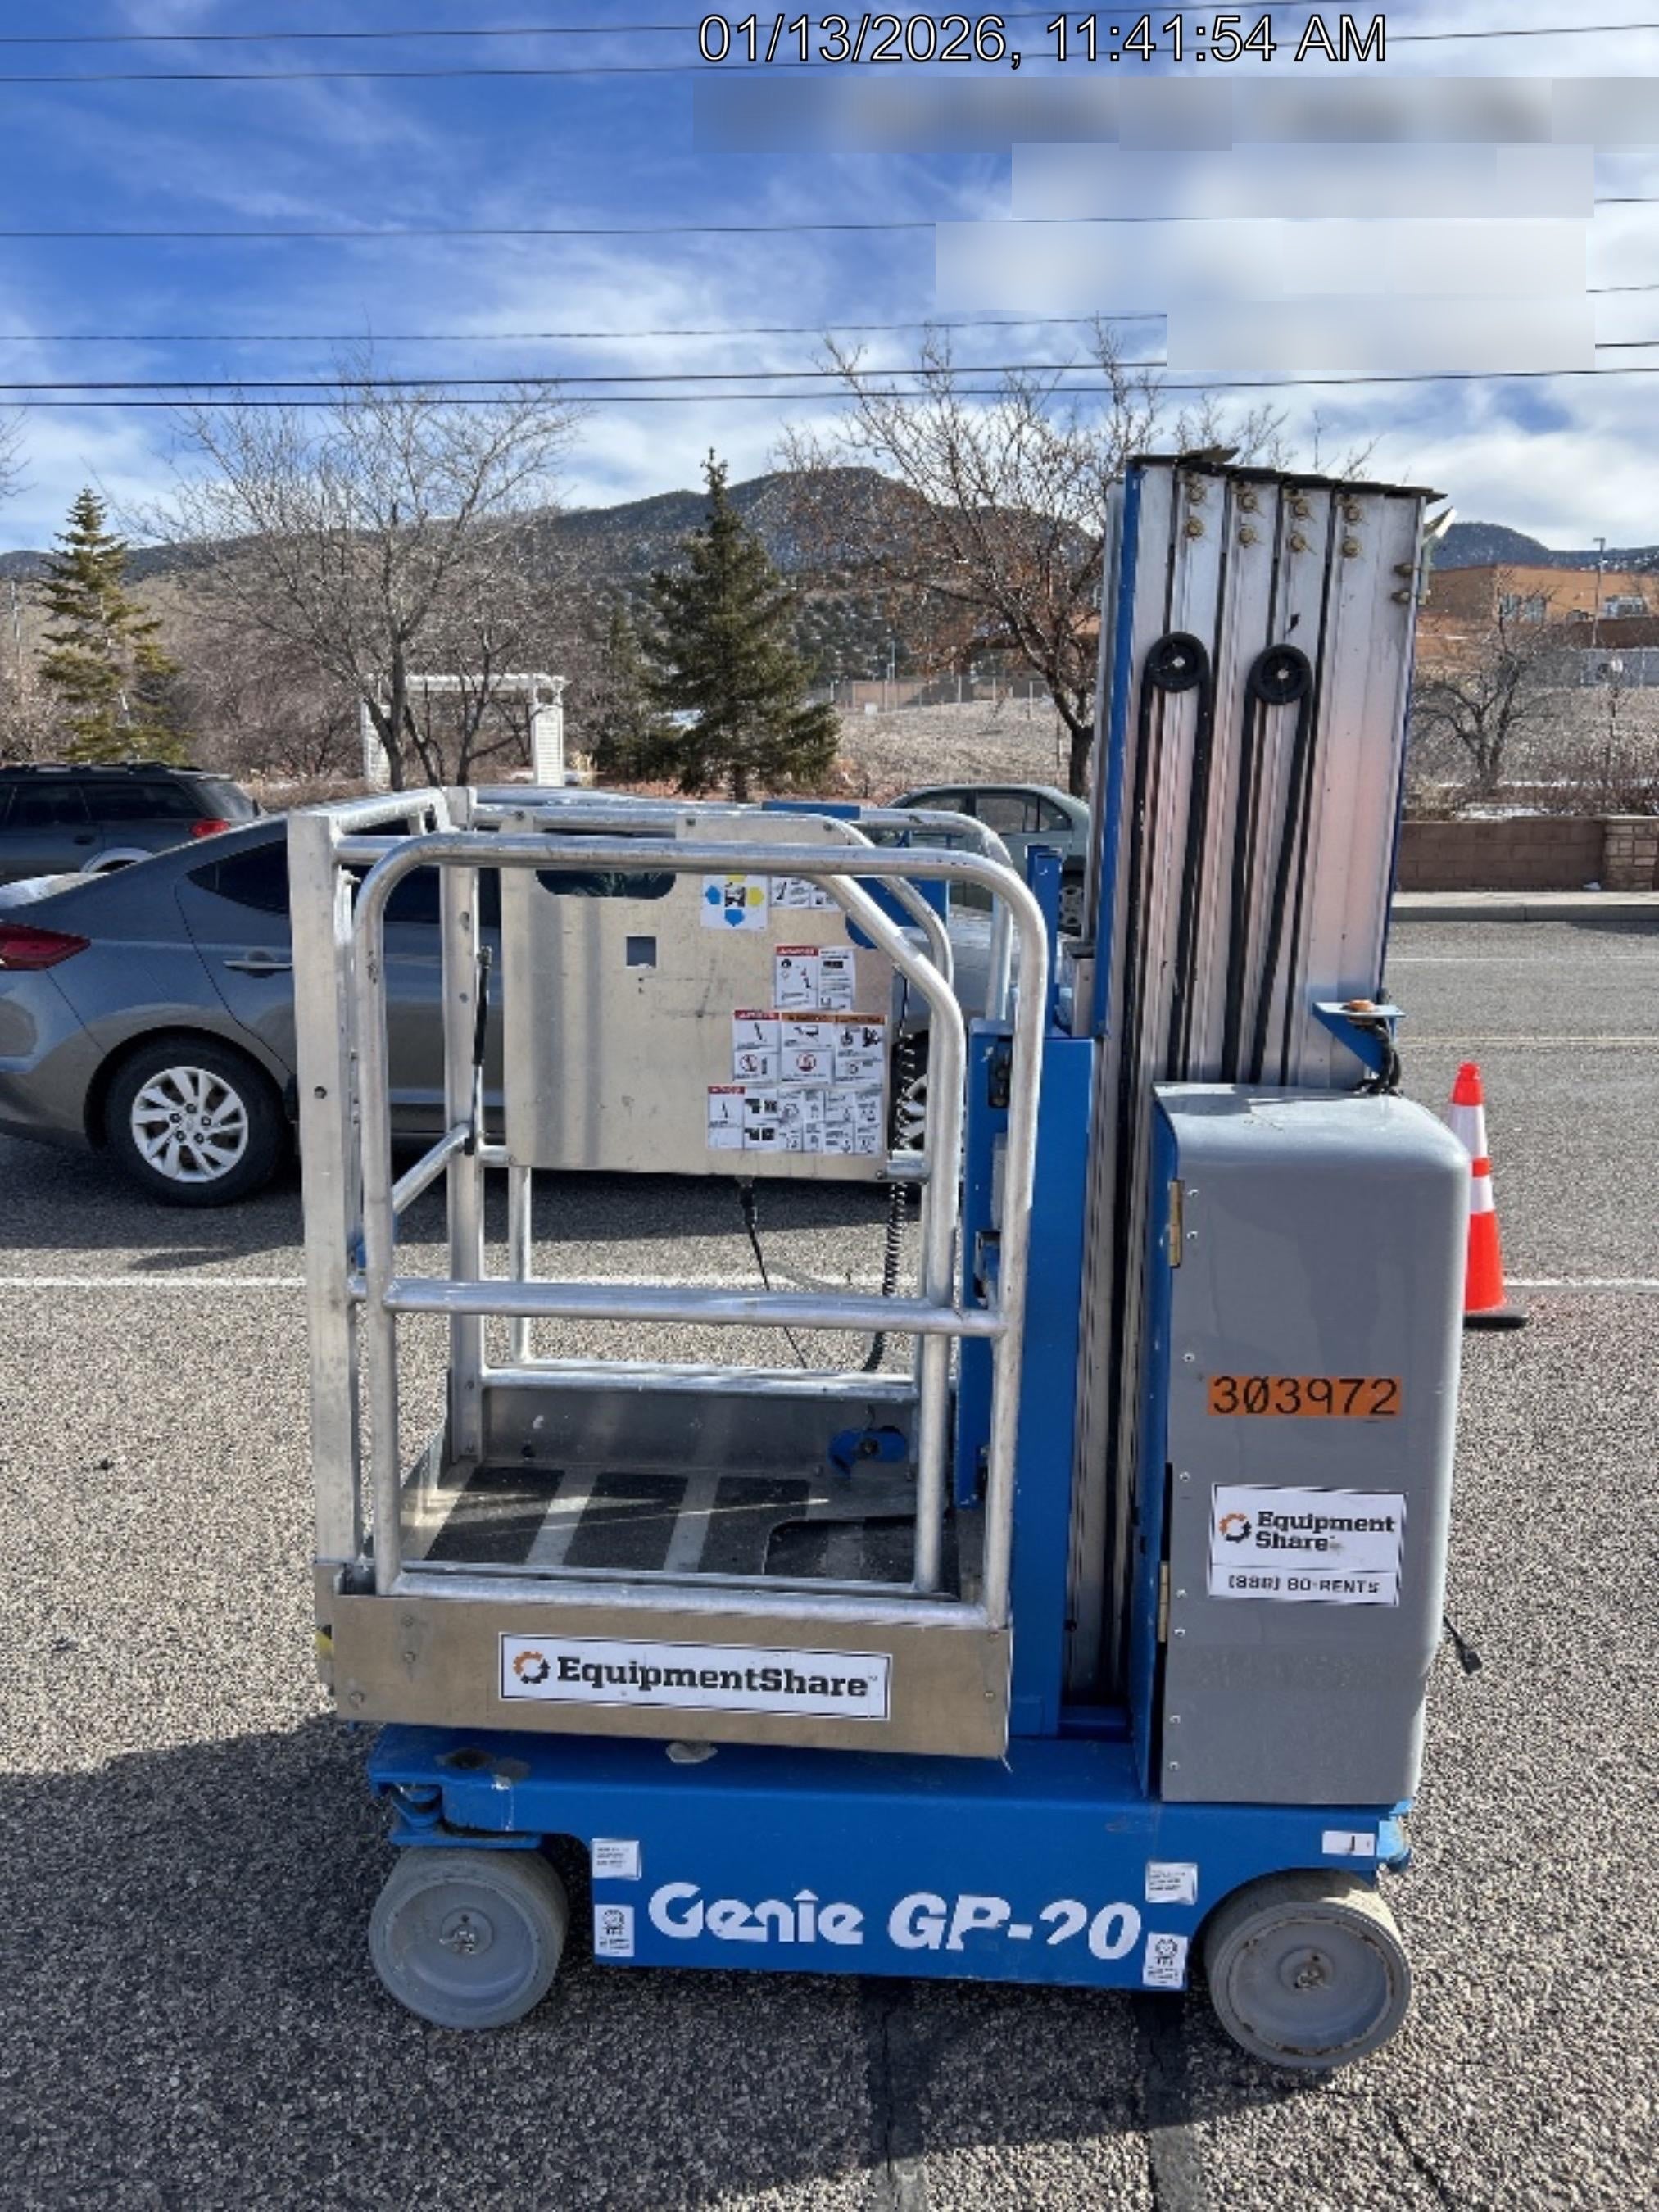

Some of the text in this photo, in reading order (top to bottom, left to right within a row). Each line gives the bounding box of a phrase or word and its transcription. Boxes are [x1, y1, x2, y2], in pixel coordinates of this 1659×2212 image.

[1213, 1376, 1398, 1415] 303972
[1255, 1531, 1329, 1552] Share
[1257, 1511, 1395, 1533] Equipment
[558, 1656, 868, 1697] EquipmentShare
[648, 1882, 1141, 1960] Genie GP-20
